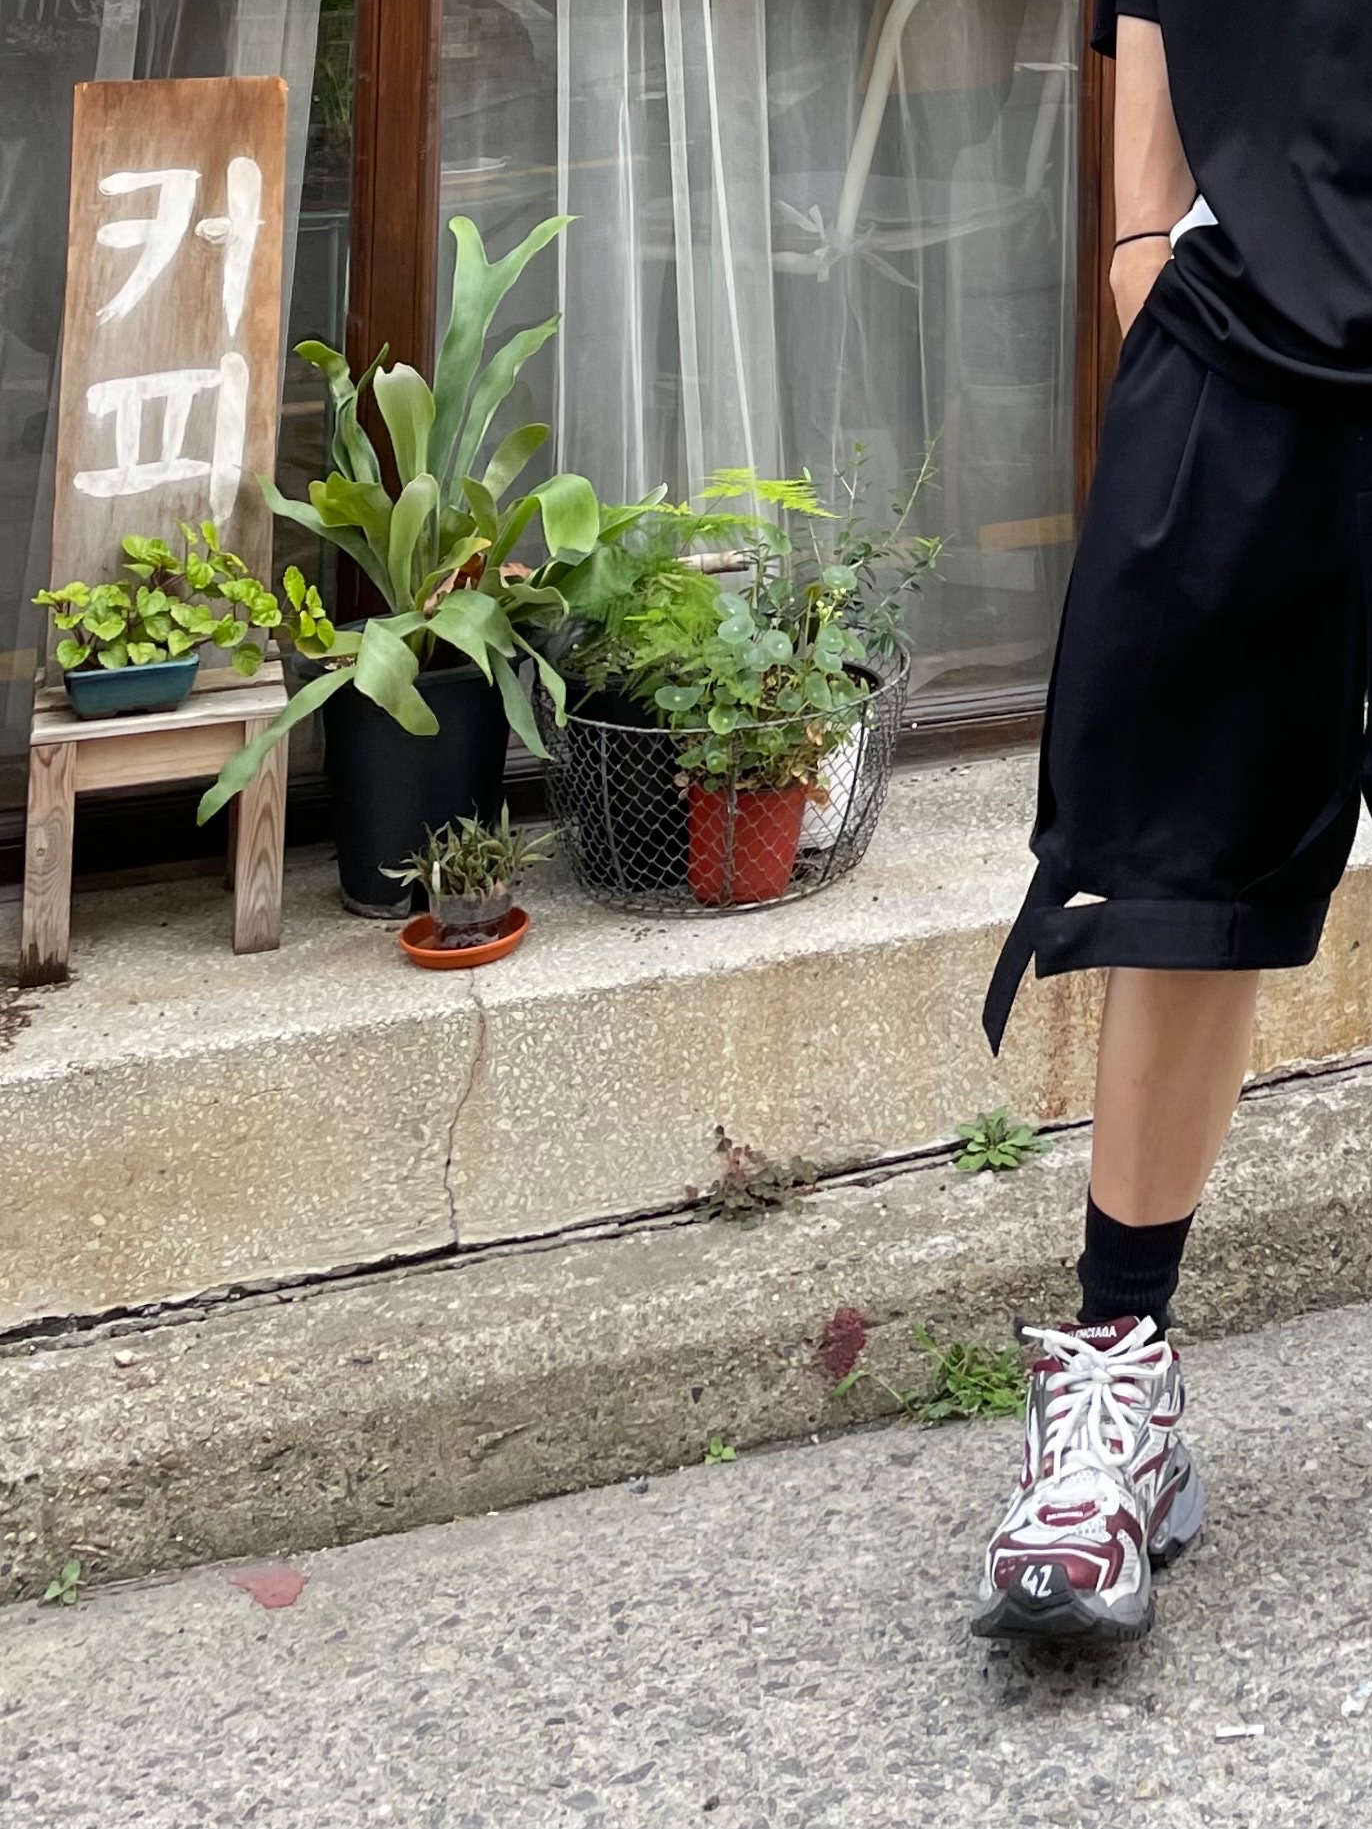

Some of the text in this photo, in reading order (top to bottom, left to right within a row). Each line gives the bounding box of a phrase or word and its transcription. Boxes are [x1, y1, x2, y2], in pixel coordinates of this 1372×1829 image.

[74, 156, 263, 526] 커피
[1066, 1325, 1117, 1339] LENCIAGA
[1021, 1564, 1053, 1598] 42
